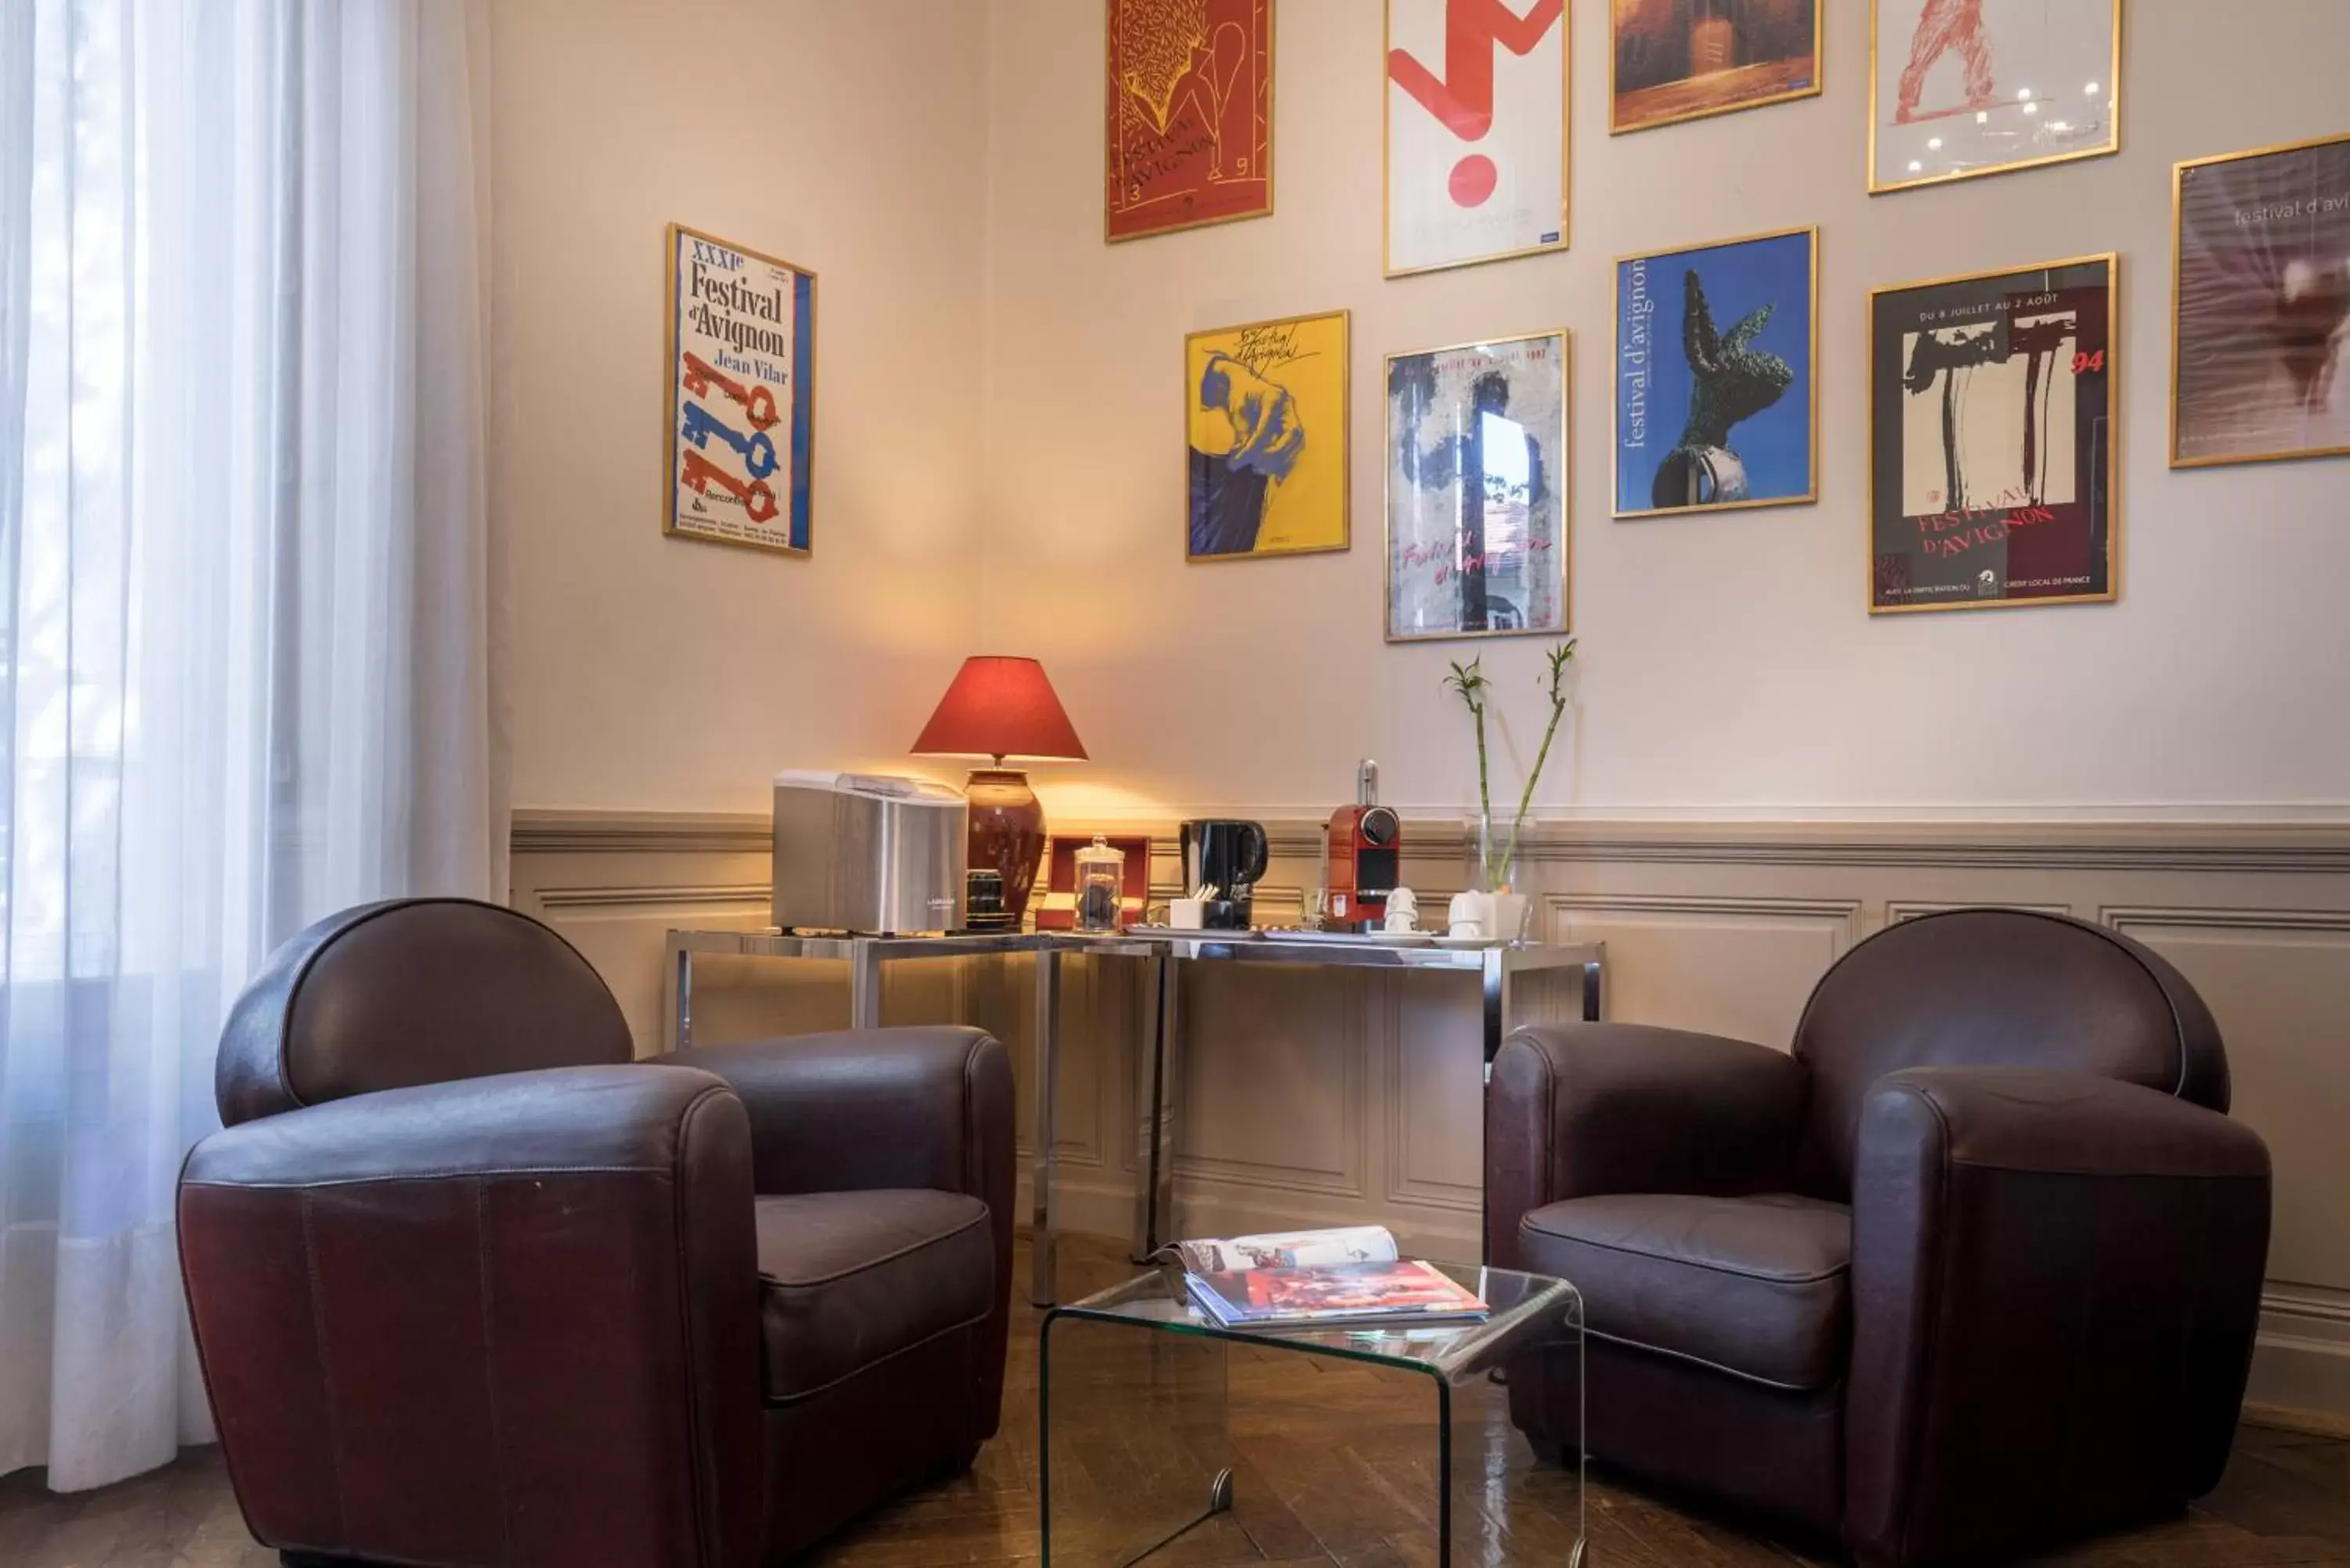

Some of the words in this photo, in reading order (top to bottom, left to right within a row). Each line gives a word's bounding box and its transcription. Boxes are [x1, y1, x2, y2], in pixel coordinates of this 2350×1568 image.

[2234, 200, 2301, 228] festival
[691, 260, 782, 324] Festival
[1624, 259, 1654, 364] d'avignon
[1920, 313, 1934, 322] DU
[1950, 303, 1990, 318] JUILLET
[1995, 301, 2010, 310] AU
[2015, 298, 2021, 308] 2
[689, 302, 785, 358] d'Avignon
[714, 349, 750, 374] Jean
[754, 359, 788, 385] Vilar
[2070, 350, 2104, 374] 94
[1624, 370, 1645, 450] festival
[1918, 486, 2030, 533] FESTIVAL
[1924, 506, 2055, 558] D'AVIGNON
[2028, 578, 2050, 587] LOCAL
